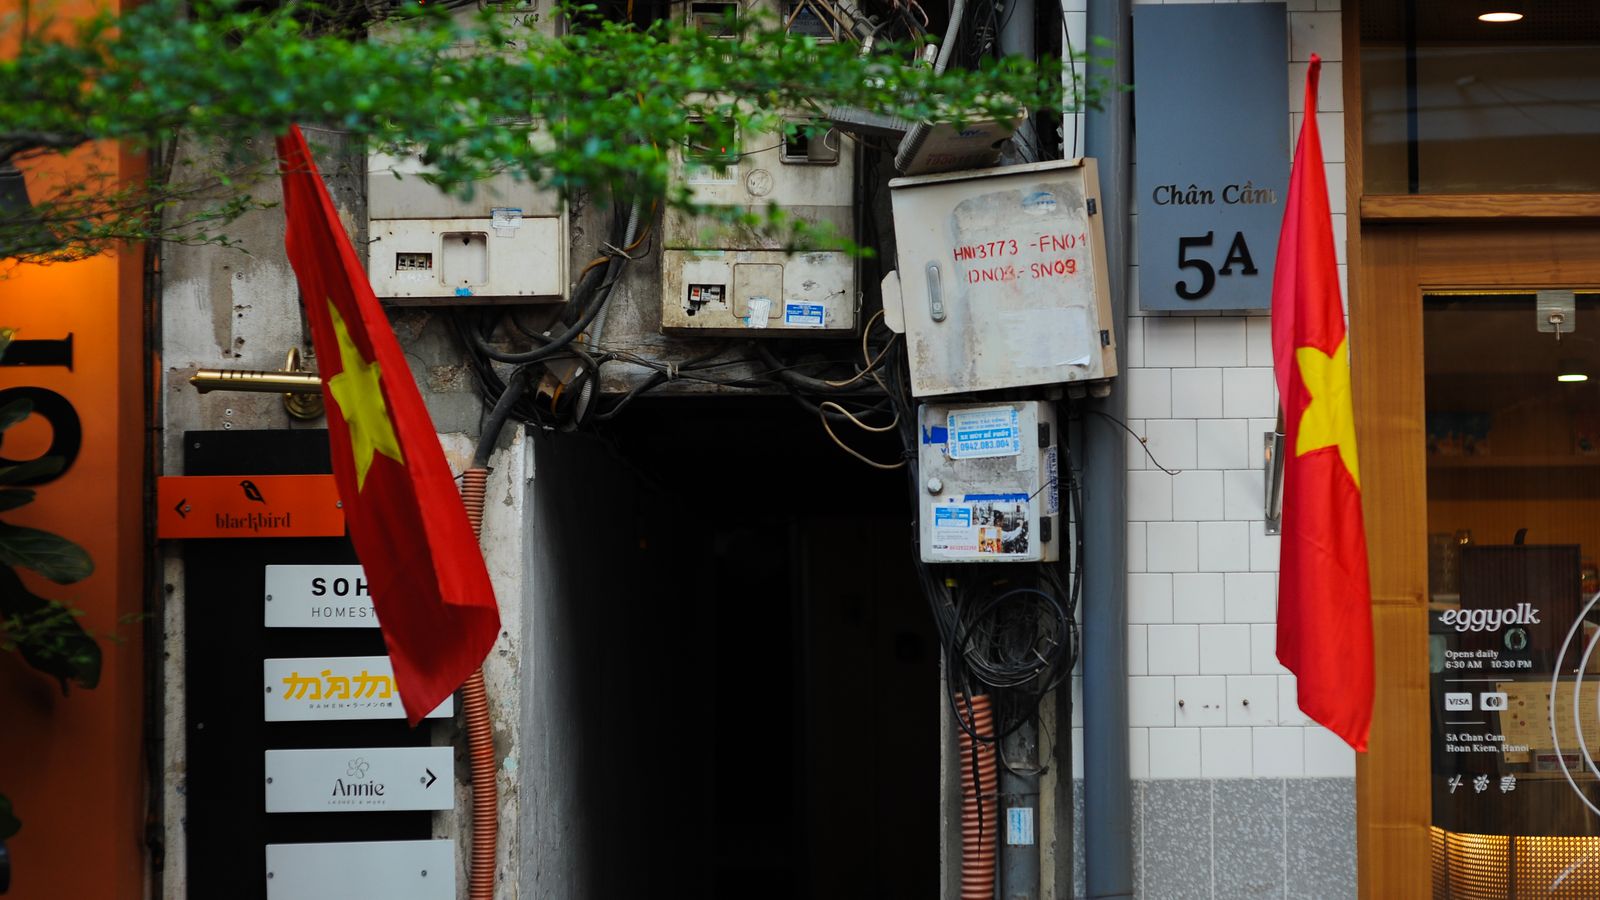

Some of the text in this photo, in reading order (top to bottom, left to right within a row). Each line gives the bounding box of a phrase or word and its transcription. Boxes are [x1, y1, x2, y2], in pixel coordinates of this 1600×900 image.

[1152, 180, 1277, 206] Chân Cầm
[1175, 231, 1258, 301] 5A
[215, 511, 291, 533] blackbird
[1438, 602, 1541, 633] eggyolk
[1445, 649, 1499, 660] Opens daily
[1445, 660, 1533, 669] 6:30 AM 10:30 PM
[1448, 698, 1470, 706] VISA
[1446, 733, 1506, 742] 5A Chan Cam
[1446, 744, 1530, 753] Hoan Kiem, Hanoi
[332, 778, 385, 796] Annie
